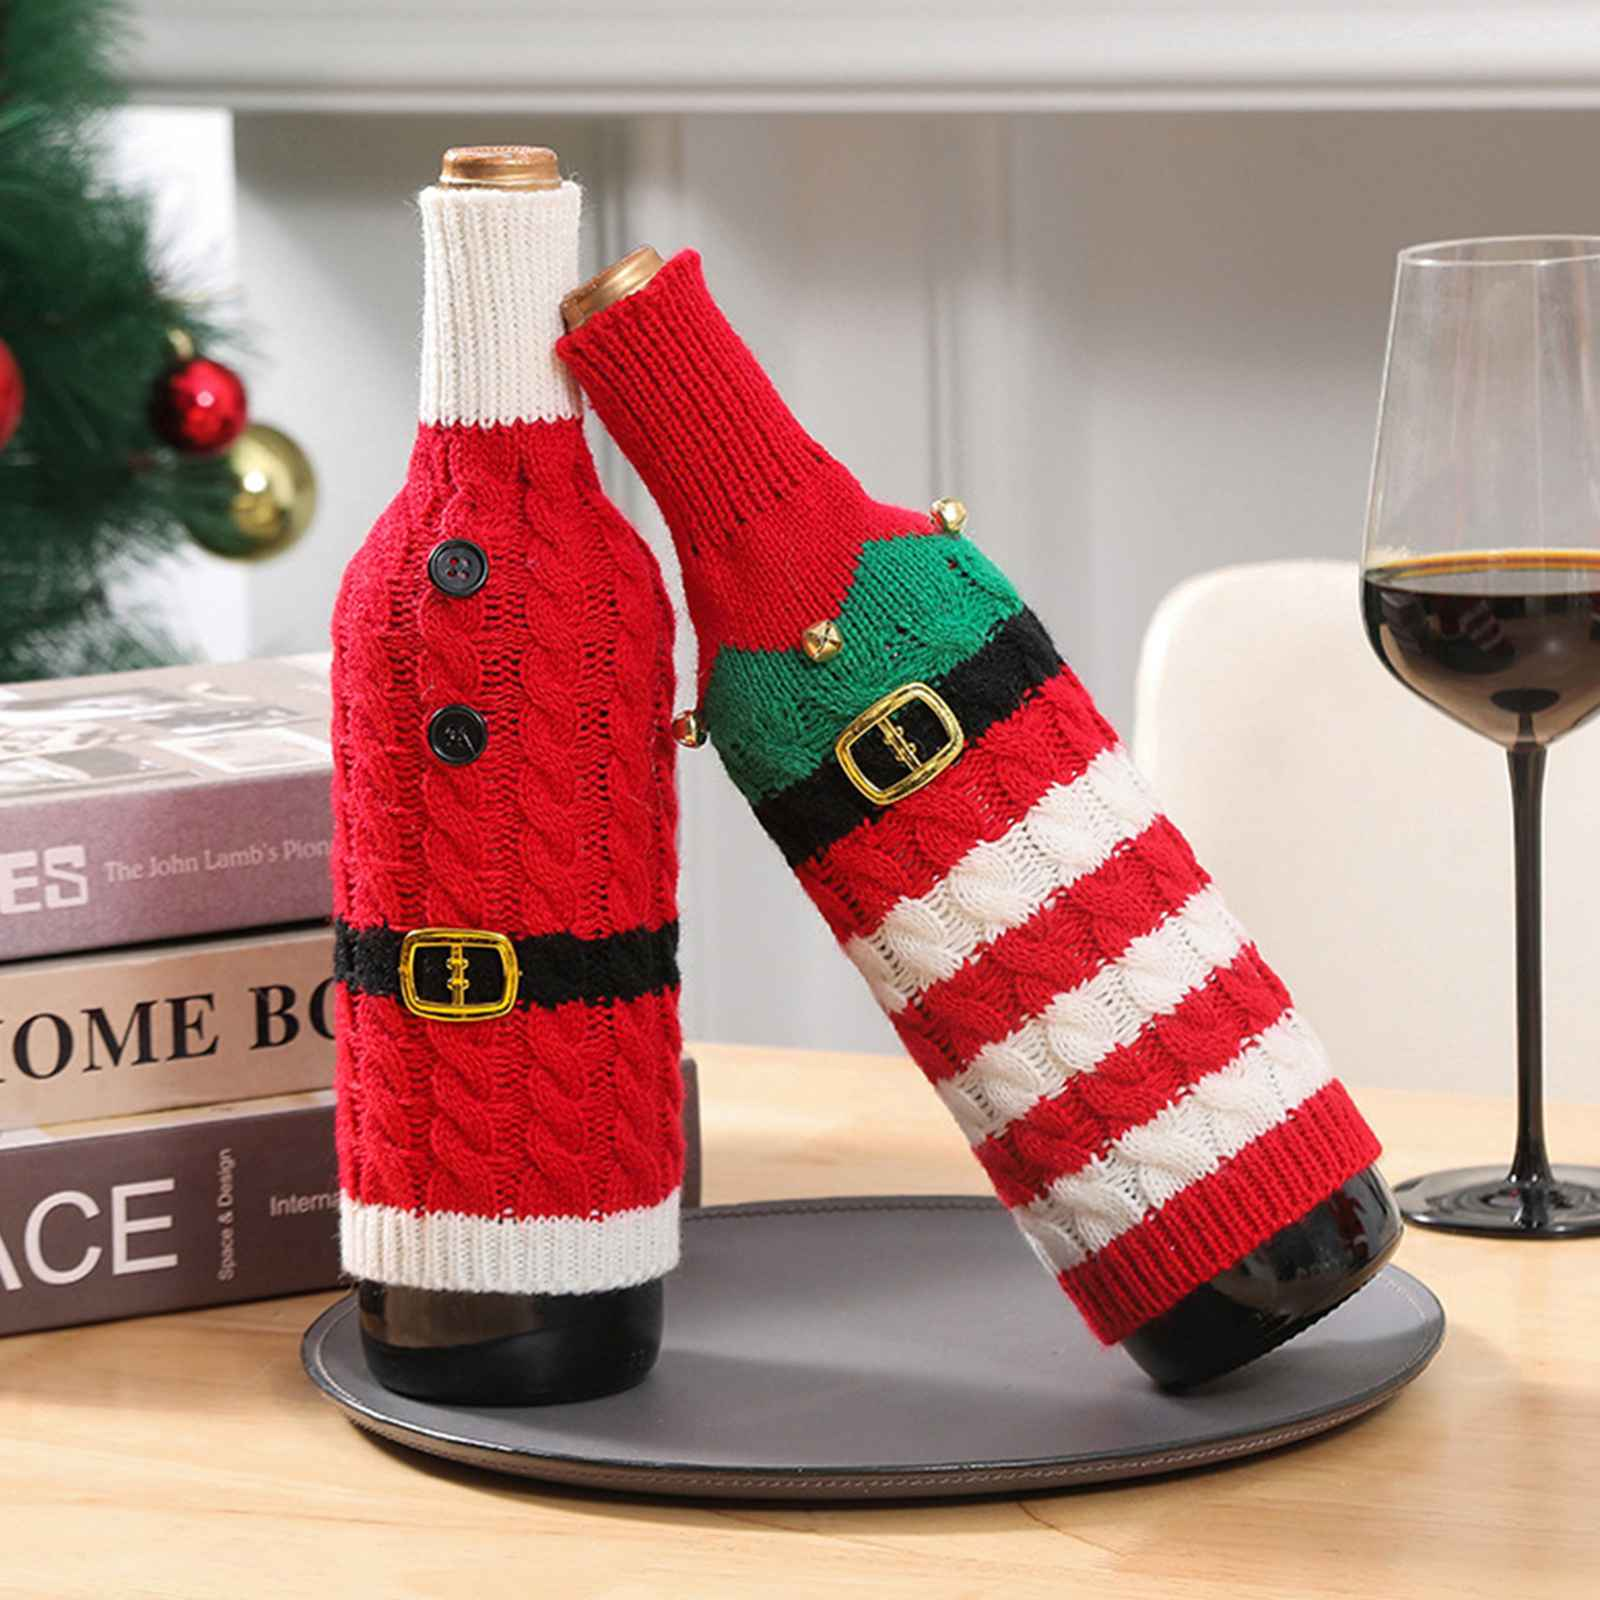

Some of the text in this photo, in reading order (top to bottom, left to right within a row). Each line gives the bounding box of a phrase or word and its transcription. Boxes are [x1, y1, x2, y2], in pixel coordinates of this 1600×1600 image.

[104, 860, 144, 883] The
[150, 853, 198, 878] John
[204, 842, 279, 871] Lamb's
[0, 993, 219, 1084] OME
[217, 1148, 236, 1281] Space & Design
